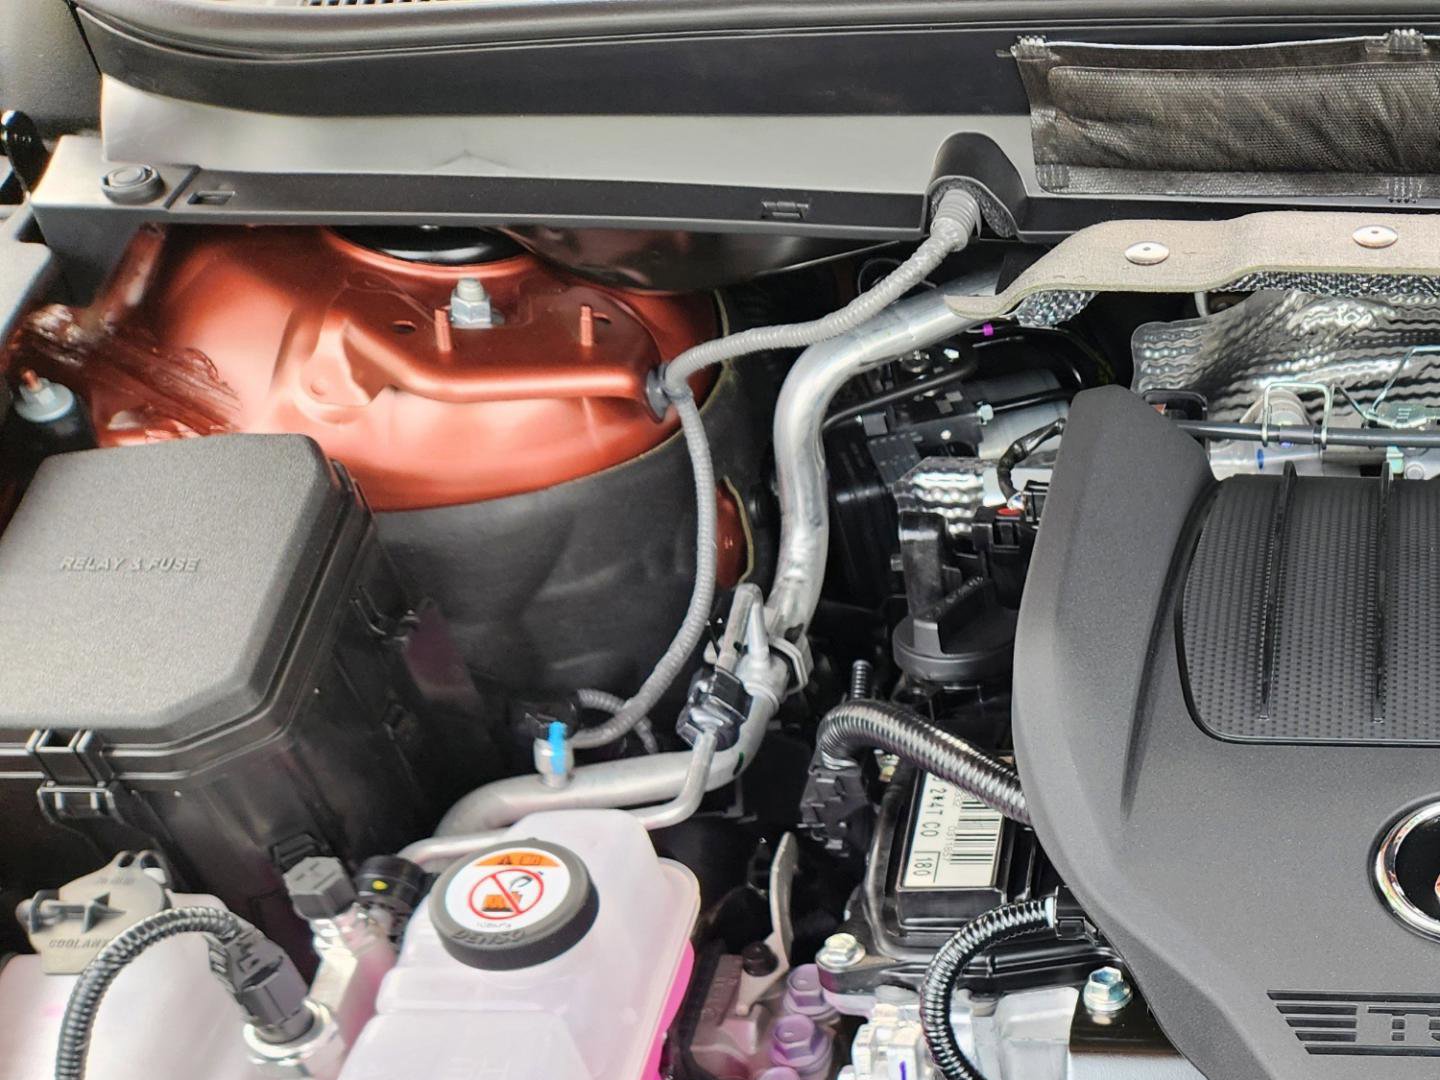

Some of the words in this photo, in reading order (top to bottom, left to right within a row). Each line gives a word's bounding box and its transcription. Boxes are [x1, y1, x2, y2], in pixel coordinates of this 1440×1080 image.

[61, 556, 125, 572] RELAY
[150, 557, 201, 572] FUSE
[913, 856, 933, 877] 180
